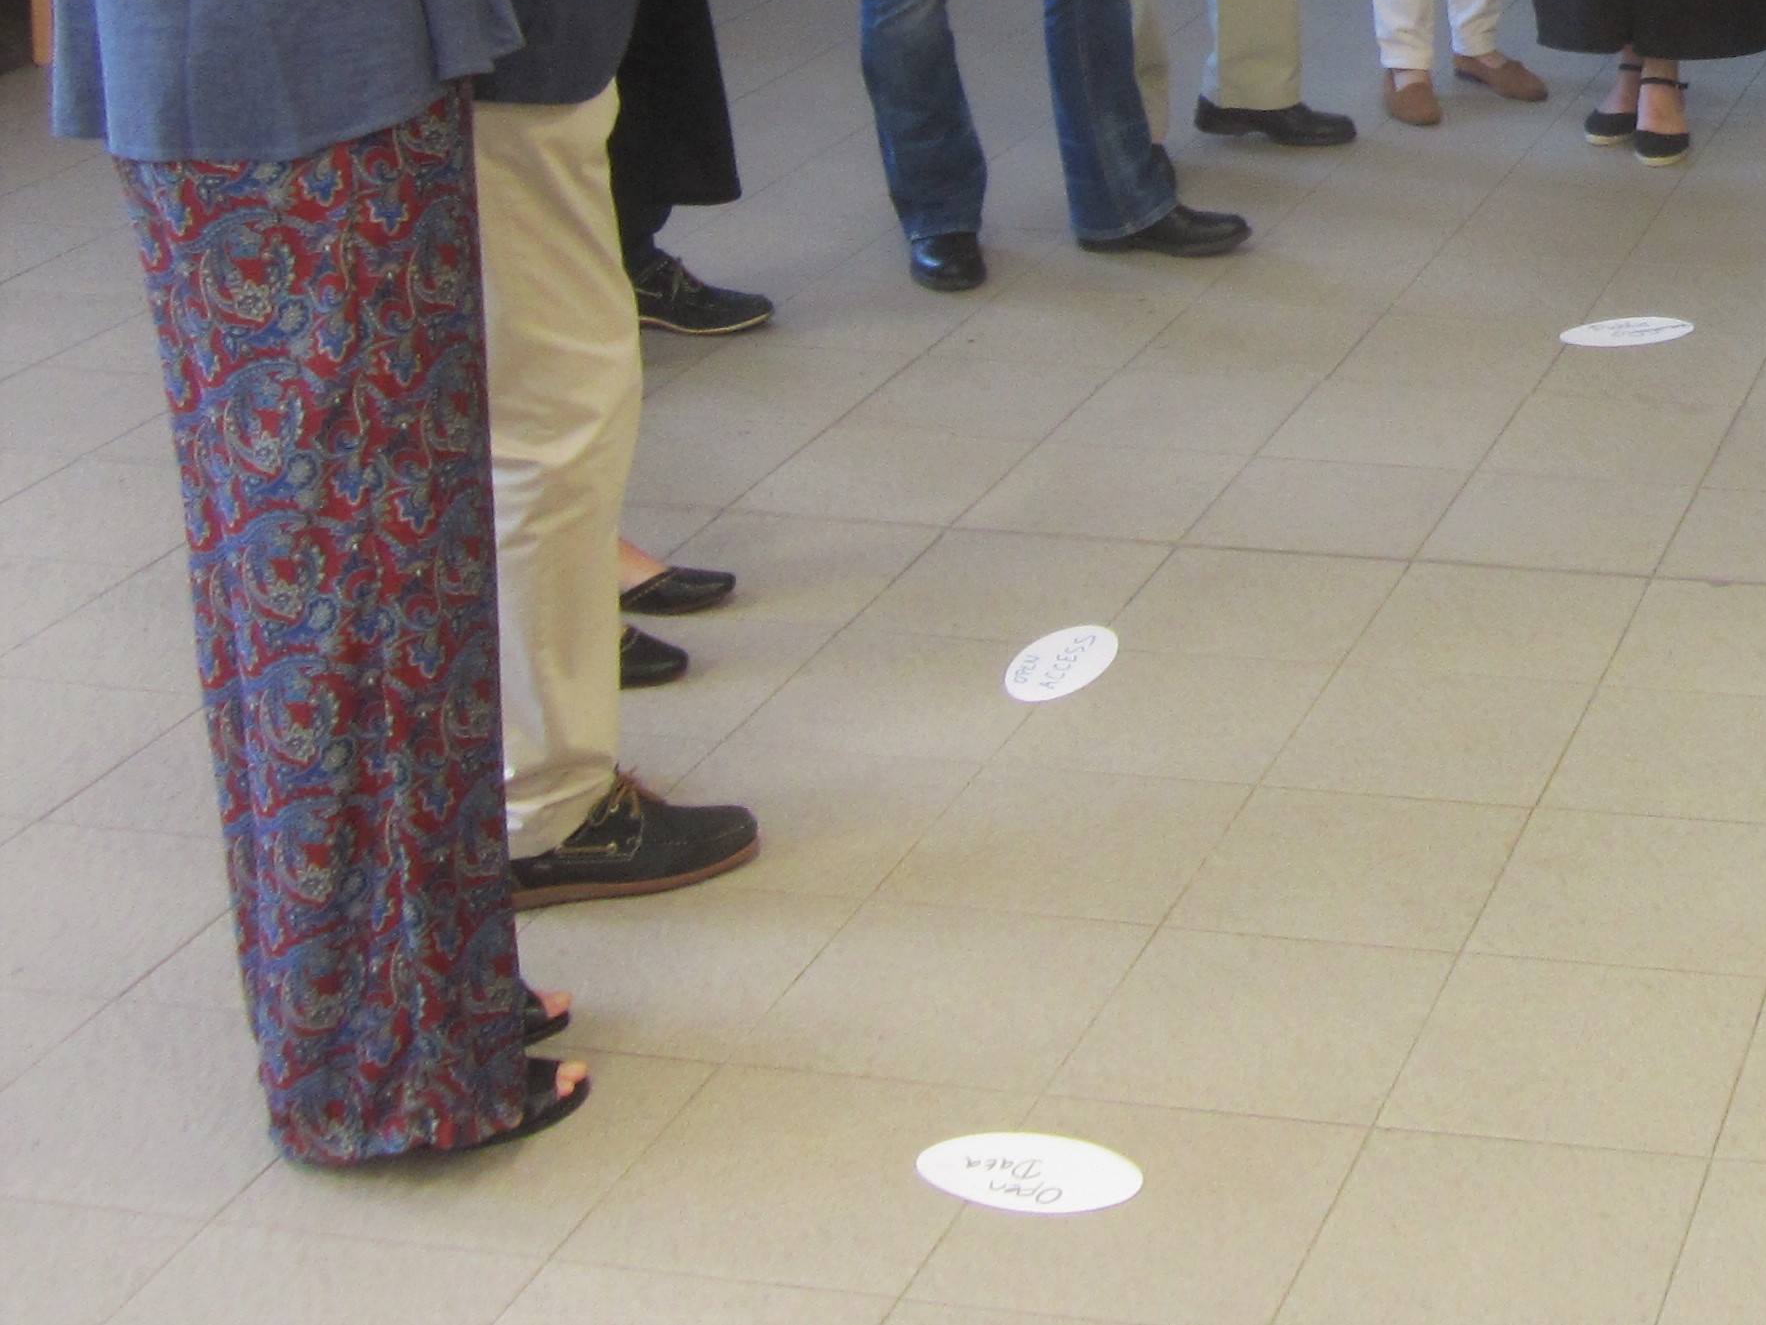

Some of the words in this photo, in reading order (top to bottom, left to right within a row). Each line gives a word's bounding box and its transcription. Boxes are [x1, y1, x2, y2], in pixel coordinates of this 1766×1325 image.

[1038, 634, 1097, 690] ACCESS
[963, 1156, 1043, 1181] Data
[988, 1180, 1063, 1206] Open
